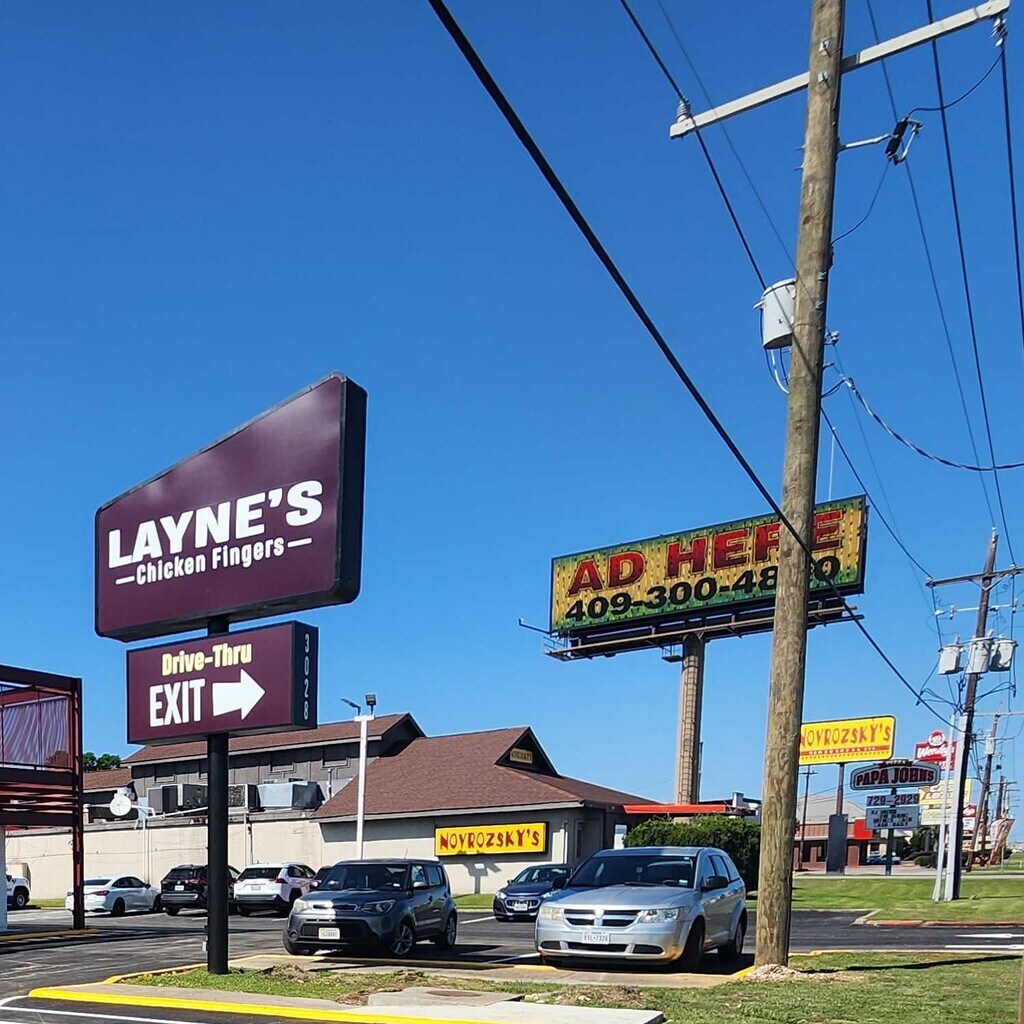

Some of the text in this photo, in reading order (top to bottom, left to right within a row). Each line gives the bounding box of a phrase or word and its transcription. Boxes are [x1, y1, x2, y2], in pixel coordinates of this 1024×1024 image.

[108, 479, 324, 568] LAYNE'S
[136, 535, 285, 586] Chicken Fingers
[567, 552, 646, 597] AD
[565, 556, 841, 622] 409-300-480
[161, 642, 252, 676] Drive-Thru
[302, 633, 311, 721] 3028
[148, 678, 206, 727] EXIT
[856, 768, 889, 786] PAPA
[868, 794, 920, 807] 729-2929
[439, 828, 541, 850] NOVROZSKY'S
